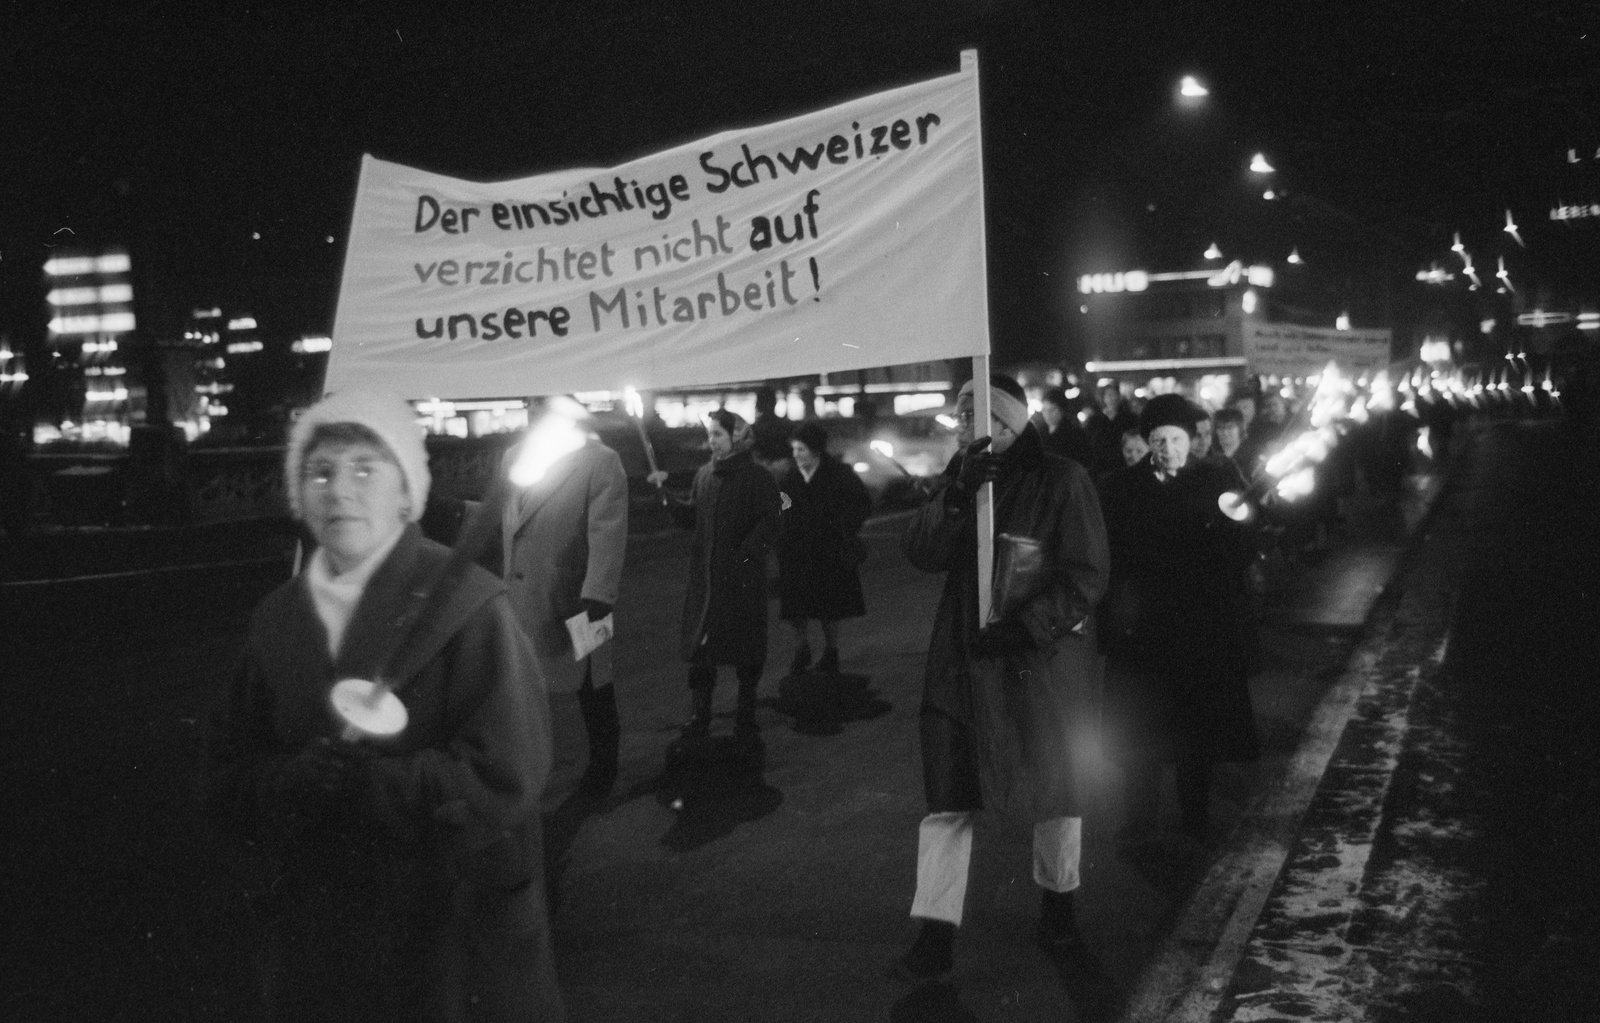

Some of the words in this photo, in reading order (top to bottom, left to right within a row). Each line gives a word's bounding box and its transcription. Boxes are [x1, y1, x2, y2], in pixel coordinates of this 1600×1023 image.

[415, 194, 480, 234] Der
[492, 174, 690, 230] einsichtige
[700, 112, 941, 193] Schweizer
[414, 242, 616, 286] verzichtet
[634, 214, 734, 271] nicht
[751, 189, 820, 252] auf
[416, 306, 571, 341] unsere
